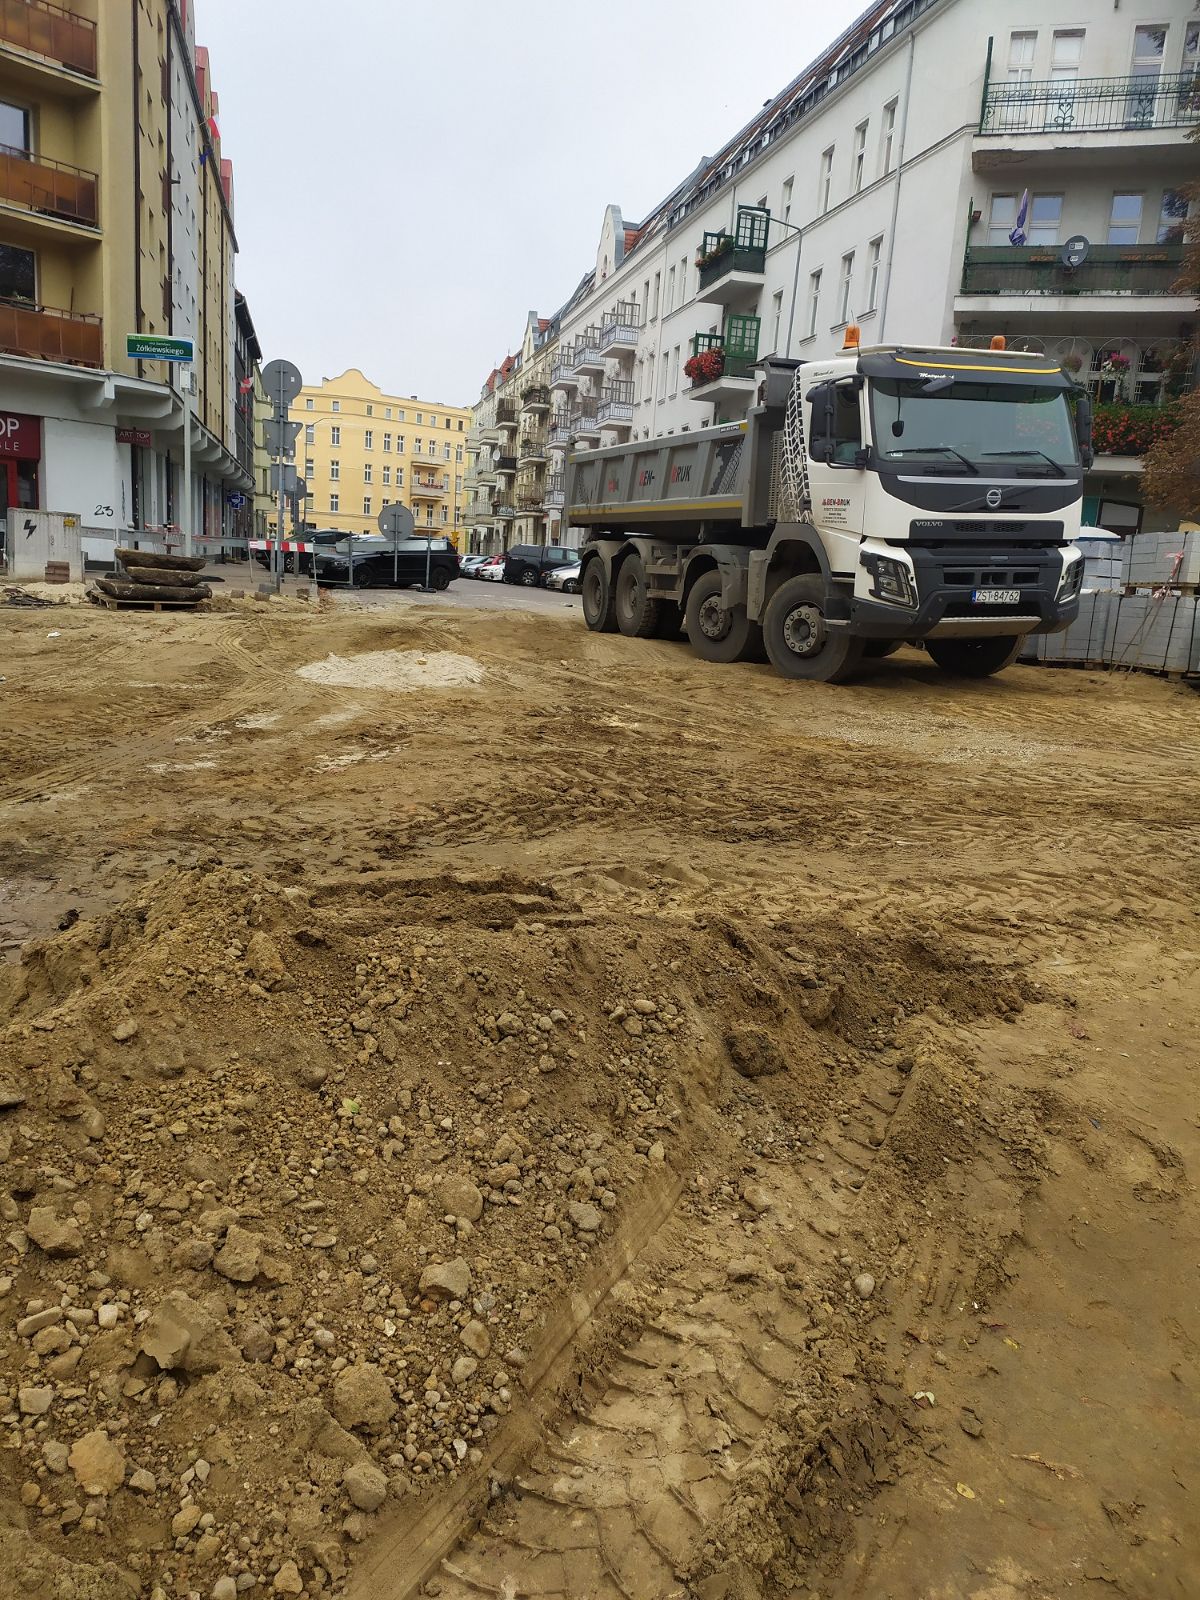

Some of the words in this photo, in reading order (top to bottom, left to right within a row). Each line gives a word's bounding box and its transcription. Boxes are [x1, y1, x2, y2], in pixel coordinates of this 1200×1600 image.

[94, 504, 114, 517] 23
[976, 591, 993, 601] ZST
[993, 591, 1019, 602] 84762
